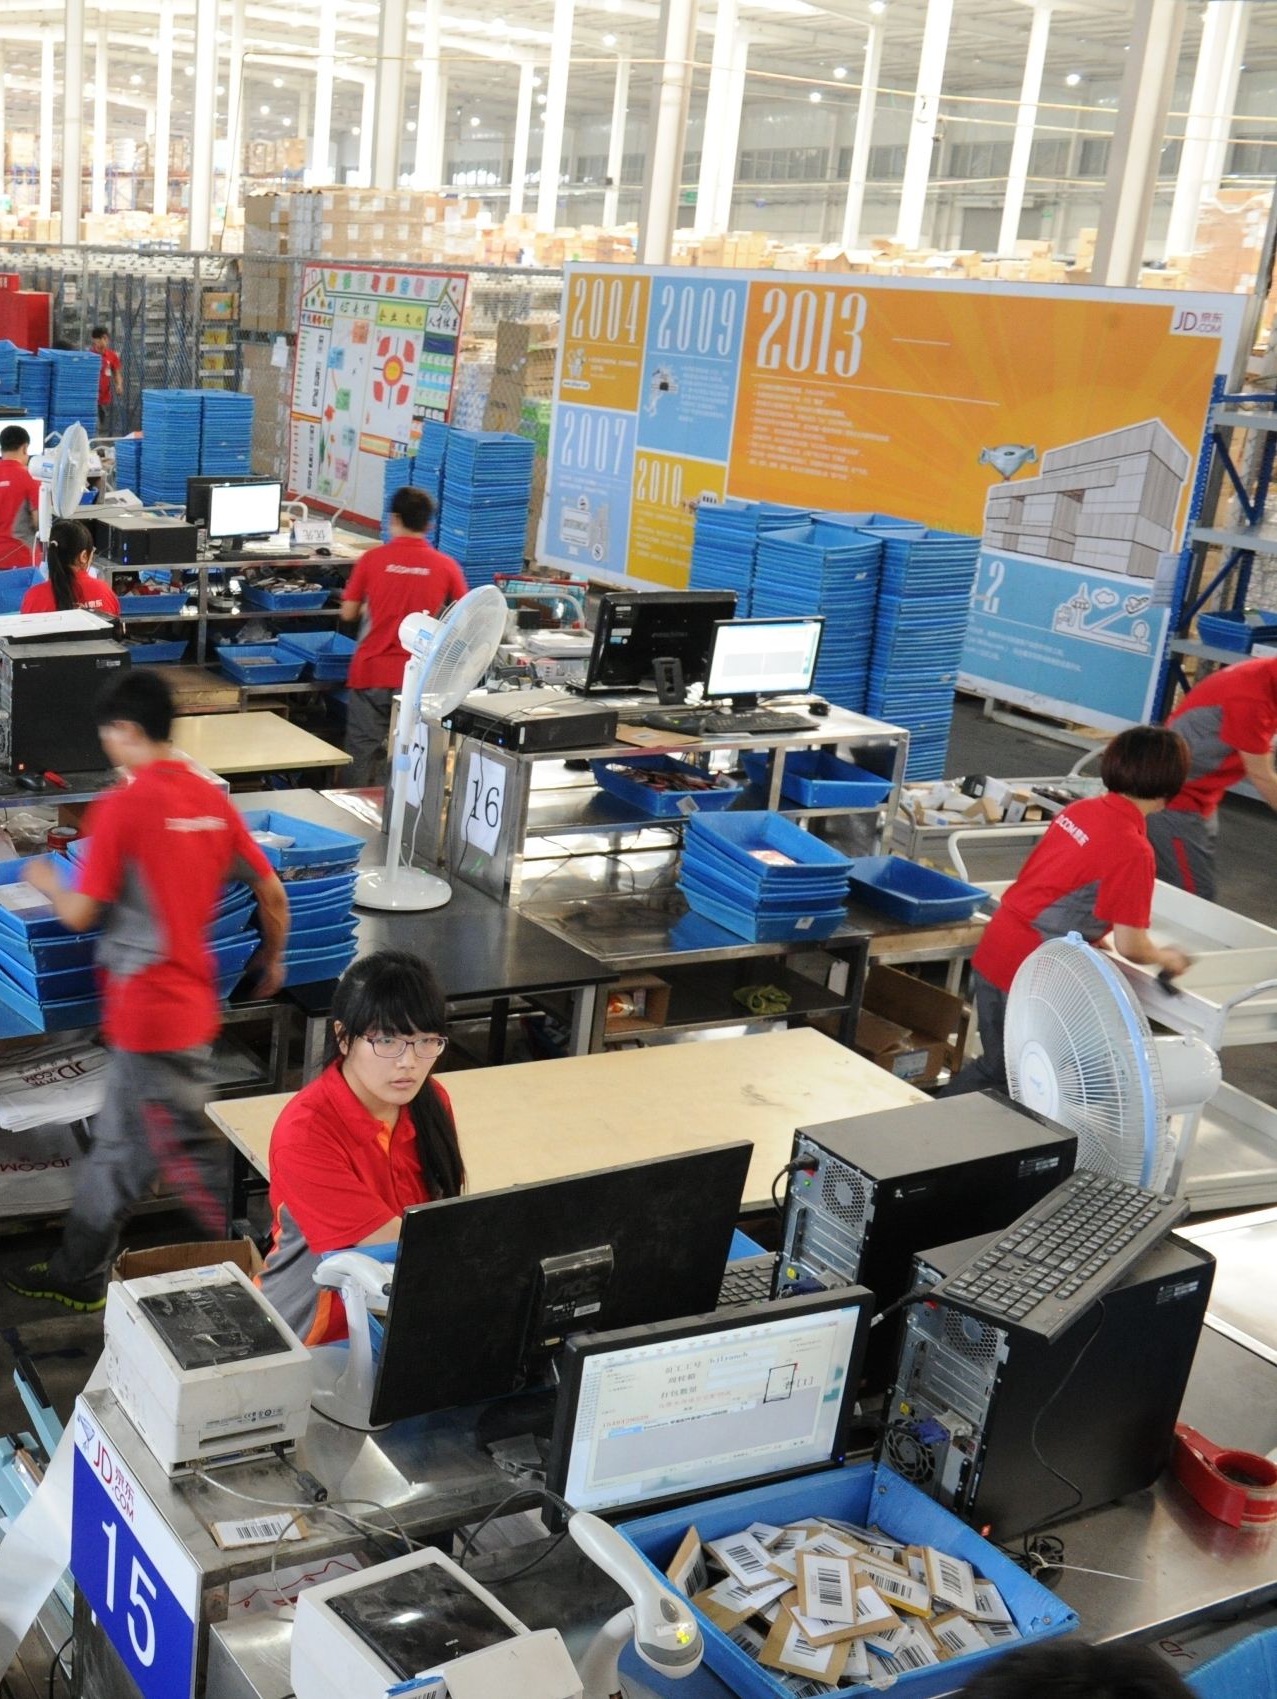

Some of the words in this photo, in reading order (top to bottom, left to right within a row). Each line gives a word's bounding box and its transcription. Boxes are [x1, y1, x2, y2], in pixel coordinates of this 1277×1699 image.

[571, 278, 641, 344] 2004
[657, 285, 736, 356] 2009
[756, 288, 868, 378] 2013
[1174, 312, 1197, 331] JD
[561, 410, 627, 476] 2007
[636, 458, 683, 508] 2010
[470, 779, 500, 828] 16
[58, 1061, 87, 1080] JD
[0, 1157, 71, 1172] JD.COM
[93, 1440, 112, 1484] JD
[115, 1465, 134, 1507] 京东
[112, 1485, 134, 1522] .COM
[102, 1521, 157, 1667] 15
